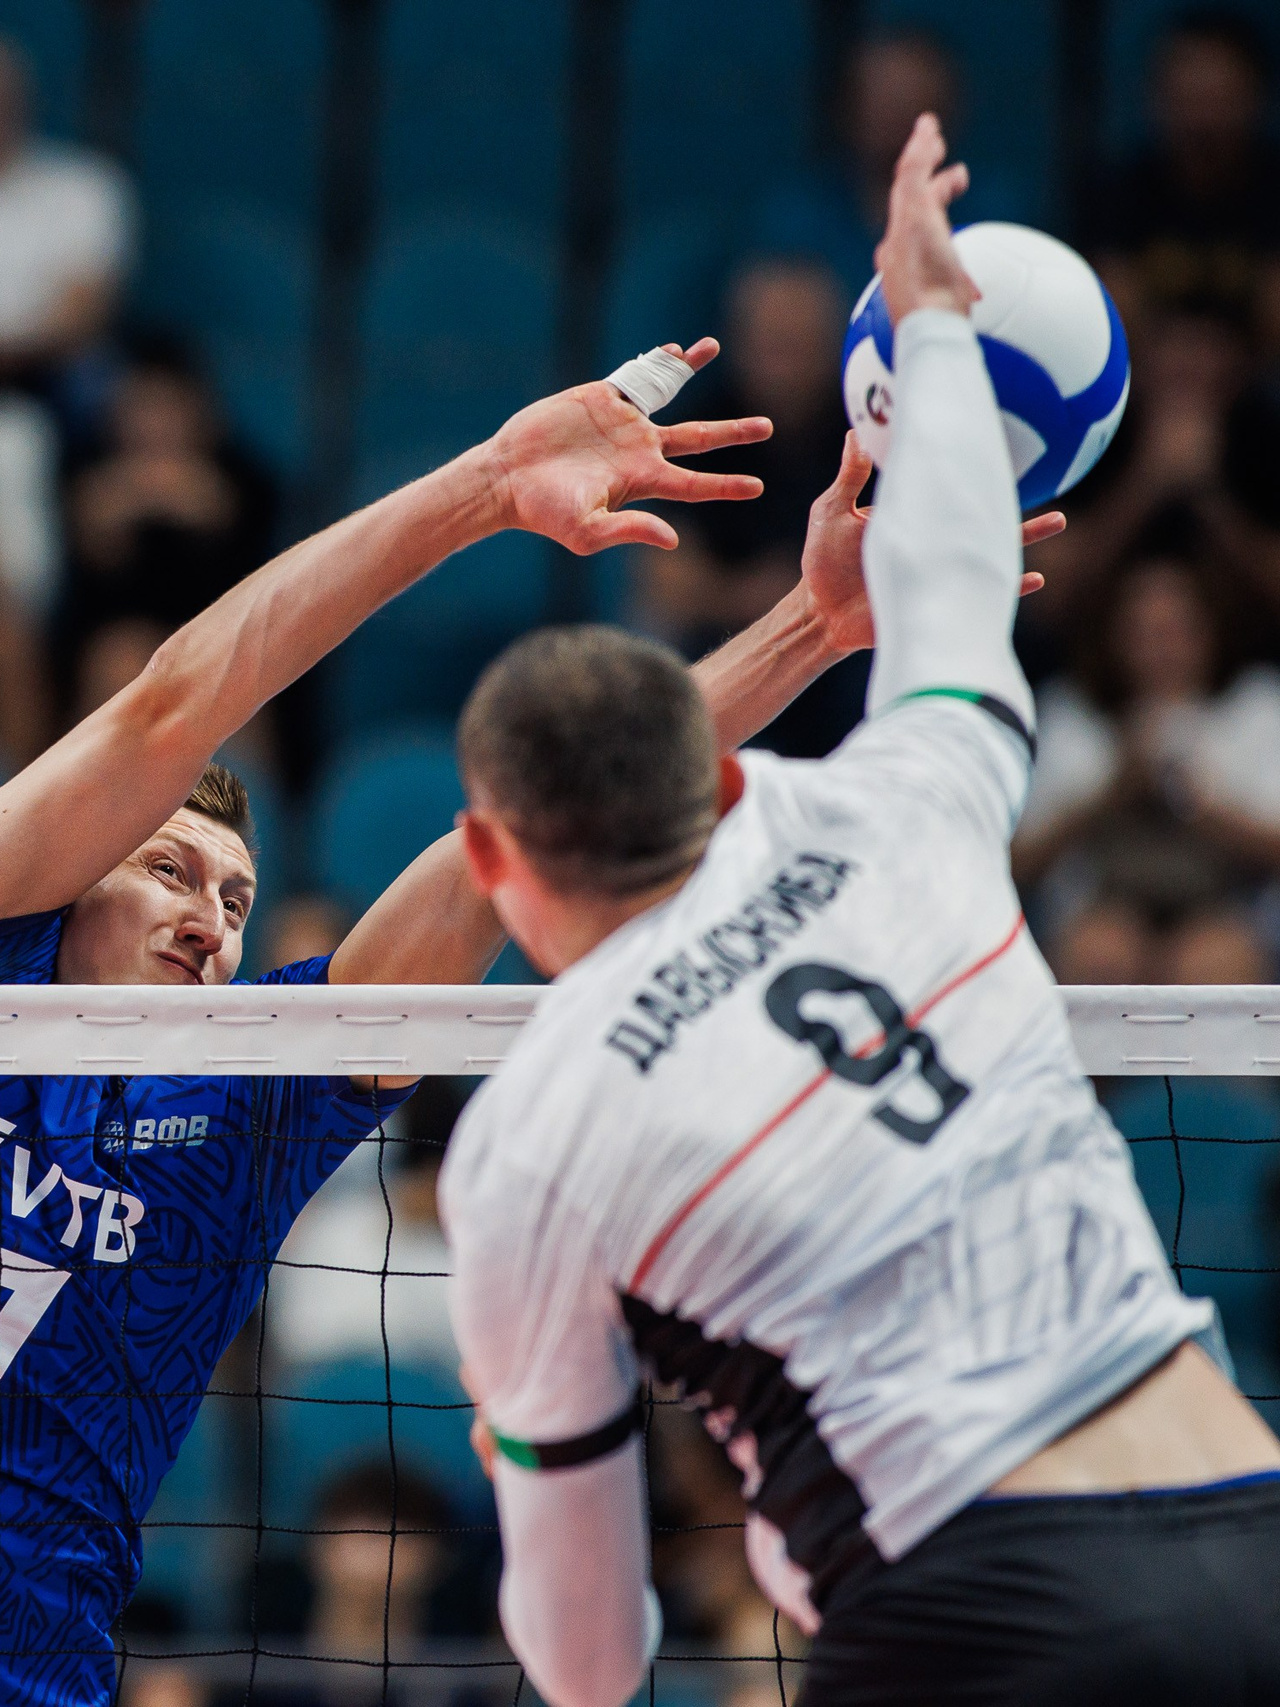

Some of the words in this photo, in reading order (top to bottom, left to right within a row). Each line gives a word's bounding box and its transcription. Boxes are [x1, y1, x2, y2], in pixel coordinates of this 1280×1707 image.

[764, 962, 972, 1146] 9
[131, 1115, 209, 1150] ВФВ
[11, 1144, 145, 1263] VTB
